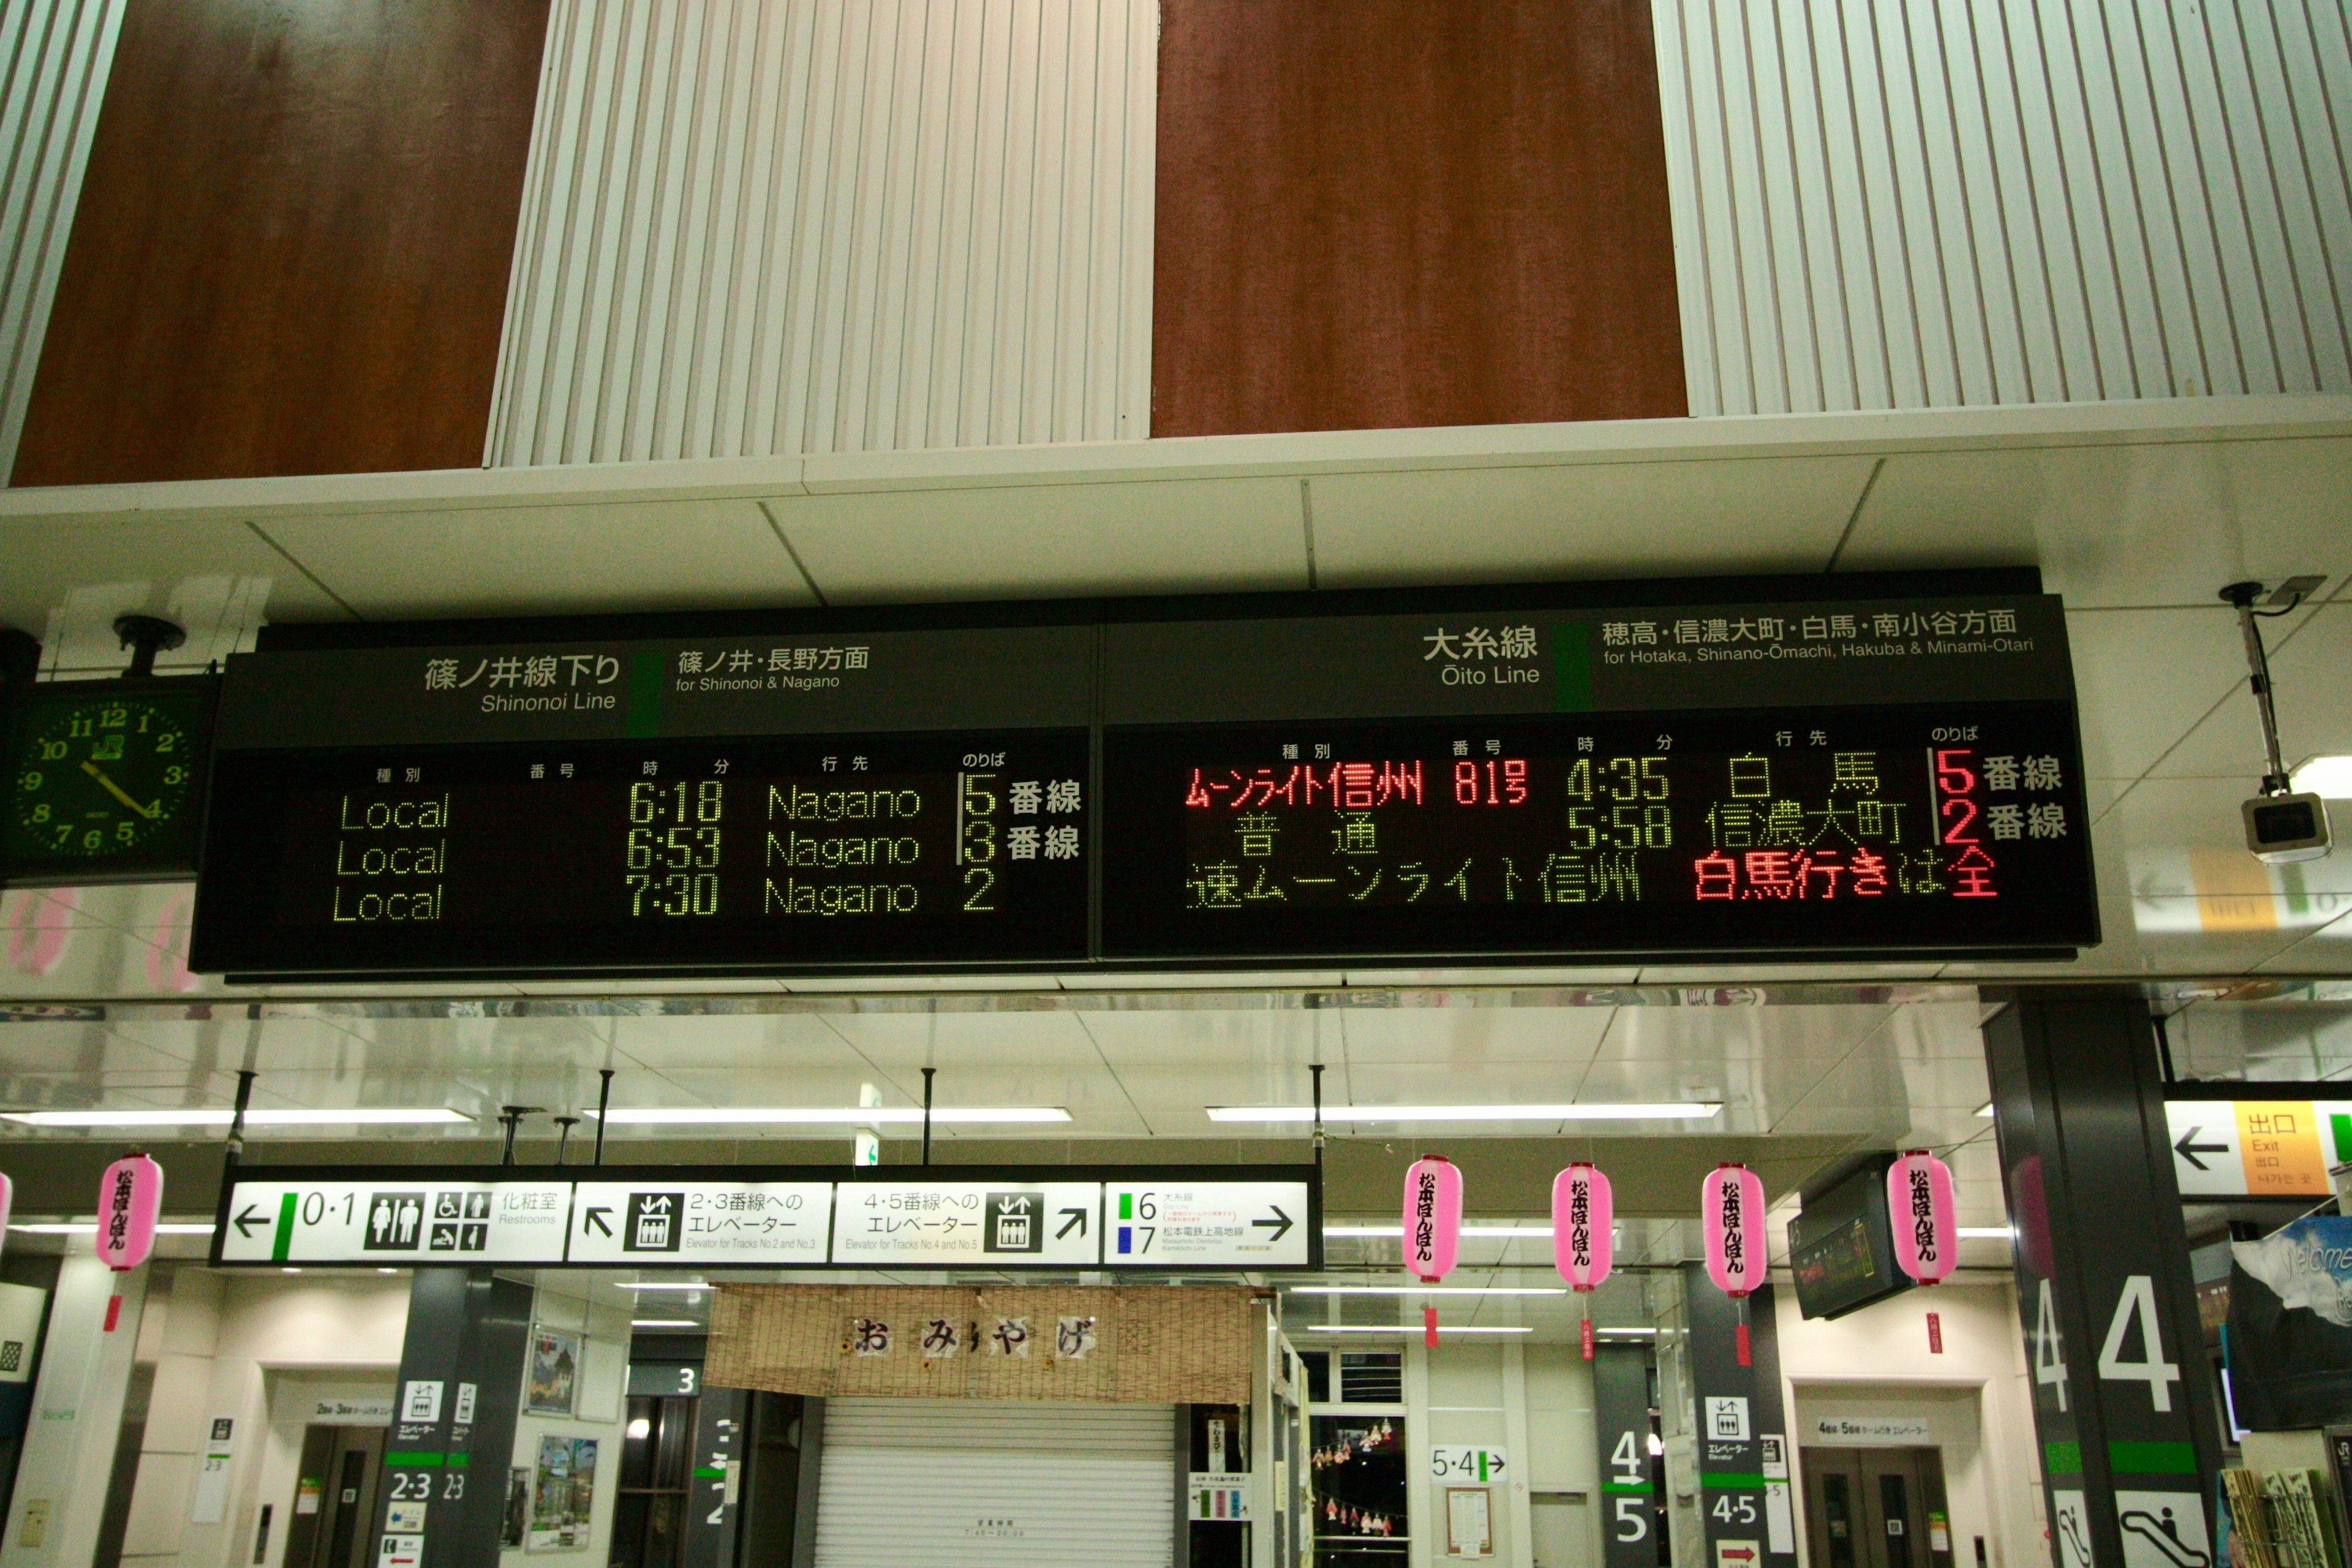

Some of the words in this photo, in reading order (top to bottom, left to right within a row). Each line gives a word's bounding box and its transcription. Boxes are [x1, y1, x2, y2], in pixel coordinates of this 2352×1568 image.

[1423, 625, 1539, 662] 大糸線
[1604, 650, 1625, 664] for
[1630, 649, 1691, 664] Hotaka,
[1842, 643, 1904, 657] Hakuba
[1910, 641, 1923, 654] &
[1928, 637, 2034, 654] Minami-Otari
[678, 646, 870, 674] 篠ノ井・長野方面
[424, 654, 620, 692] 篠ノ井線下り
[1441, 665, 1486, 685] Ōito
[1494, 666, 1540, 684] Line
[676, 678, 696, 692] for
[699, 677, 763, 692] Shinonoi
[766, 677, 777, 688] &
[783, 676, 840, 691] Nagano
[481, 692, 567, 712] Shinonoi
[574, 692, 616, 710] Line
[69, 719, 92, 737] 11
[99, 709, 127, 727] 12
[138, 715, 148, 733] 1
[41, 741, 68, 760] 10
[156, 734, 175, 752] 2
[1282, 743, 1331, 760] 種別
[1452, 739, 1501, 756] 番号
[1577, 736, 1594, 753] 時
[1657, 735, 1673, 750] 分
[1776, 729, 1827, 747] 行先
[1931, 725, 1978, 742] のりば
[164, 766, 183, 785] 3
[376, 767, 421, 783] 種別
[530, 763, 575, 780] 番号
[643, 761, 658, 775] 時
[714, 759, 729, 774] 分
[822, 756, 868, 772] 行先
[962, 752, 1006, 767] のりば
[24, 772, 42, 791] 9
[1186, 760, 1422, 808] ムーンライト信州
[1455, 760, 1528, 805] 81号
[1567, 757, 1668, 801] 4:35
[1937, 749, 1975, 794] 5
[1982, 754, 2063, 791] 番線
[145, 799, 162, 818] 4
[342, 793, 448, 829] Local
[630, 781, 722, 823] 6:18
[769, 784, 920, 821] Nagano
[965, 774, 996, 816] 5
[1009, 778, 1082, 815] 番線
[32, 804, 50, 823] 8
[56, 824, 74, 844] 7
[116, 821, 134, 840] 5
[1569, 805, 1672, 850] 5:58
[1705, 799, 1906, 846] 信濃大町
[1942, 798, 1979, 844] 2
[1986, 802, 2067, 840] 番線
[83, 830, 101, 849] 6
[337, 839, 445, 875] Local
[627, 827, 720, 869] 6:53
[767, 831, 919, 868] Nagano
[964, 820, 995, 864] 3
[1006, 825, 1080, 861] 番線
[334, 884, 442, 921] Local
[626, 873, 718, 916] 7:30
[765, 877, 918, 916] Nagano
[963, 867, 995, 911] 2
[2248, 1113, 2296, 1135] 出口
[2252, 1139, 2279, 1152] Exit
[2255, 1156, 2279, 1168] 出口
[502, 1191, 557, 1210] 化粧室
[1139, 1193, 1156, 1220] 6
[499, 1213, 556, 1225] Restrooms
[688, 1216, 797, 1234] エレベーター
[867, 1216, 978, 1234] エレベーター
[1139, 1227, 1156, 1254] 7
[1163, 1226, 1244, 1237] 松本電鉄上高地線
[686, 1238, 718, 1249] Elevator
[720, 1238, 730, 1248] for
[732, 1238, 758, 1249] Tracks
[760, 1238, 778, 1249] No.2
[780, 1238, 795, 1249] and
[797, 1238, 815, 1249] No.3
[846, 1239, 877, 1250] Elevator
[880, 1239, 891, 1250] for
[892, 1239, 918, 1250] Tracks
[921, 1240, 940, 1250] No.4
[942, 1239, 956, 1250] and
[958, 1240, 977, 1250] No.5
[855, 1317, 1093, 1356] おみやげ
[2036, 1278, 2068, 1412] 4
[2098, 1275, 2180, 1412] 4
[677, 1368, 695, 1393] 3
[1611, 1431, 1641, 1475] 4
[1708, 1444, 1749, 1454] エレベーター
[1616, 1498, 1647, 1543] 5
